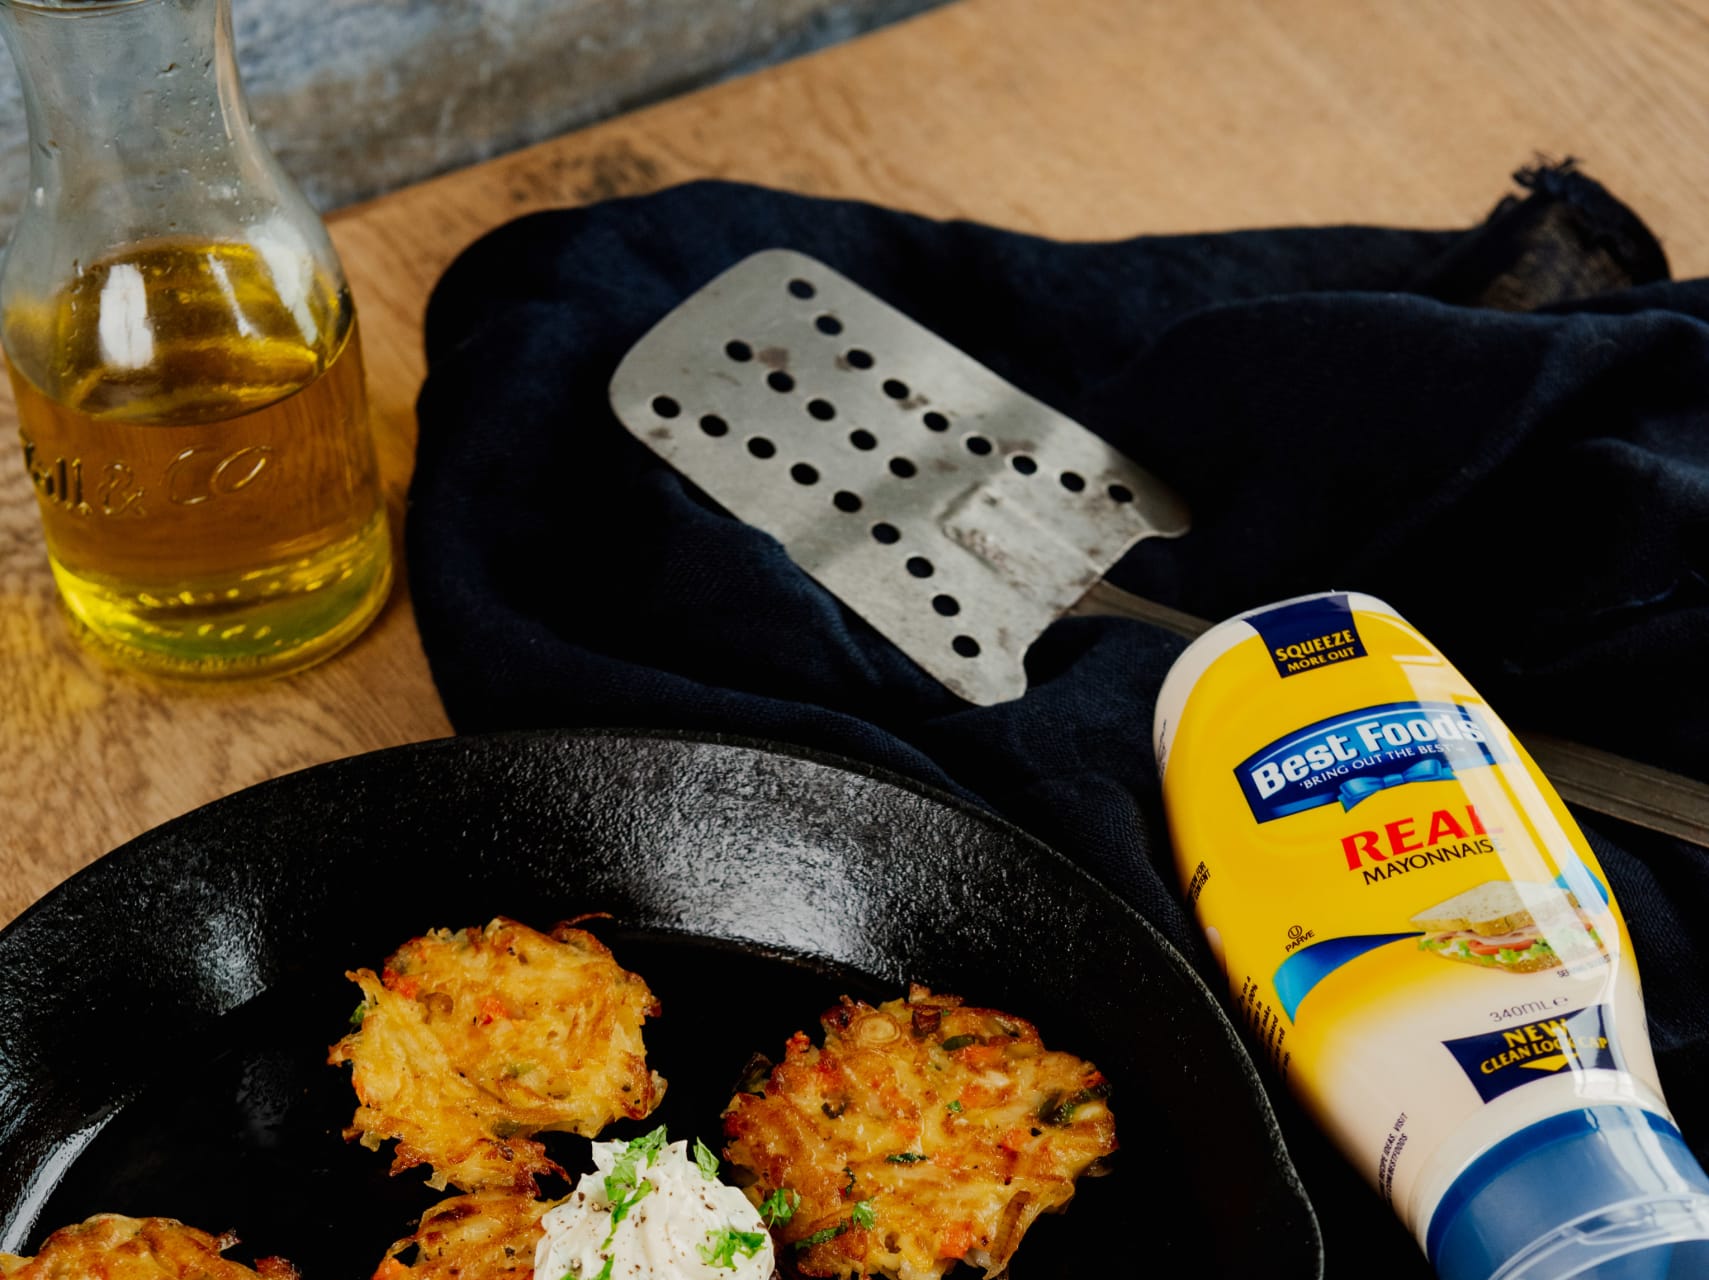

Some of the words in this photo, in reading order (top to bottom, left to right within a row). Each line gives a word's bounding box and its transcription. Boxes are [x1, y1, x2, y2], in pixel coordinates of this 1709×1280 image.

[1275, 629, 1355, 662] SQUEEZE
[1287, 655, 1327, 672] MORE
[1327, 646, 1355, 660] OUT
[1251, 734, 1357, 800] Best
[1356, 713, 1487, 756] Foods
[1352, 755, 1383, 770] OUT
[1386, 747, 1416, 761] THE
[1285, 930, 1316, 952] PARVE
[1502, 1018, 1568, 1048] NEW
[1480, 1045, 1532, 1075] CLEAN
